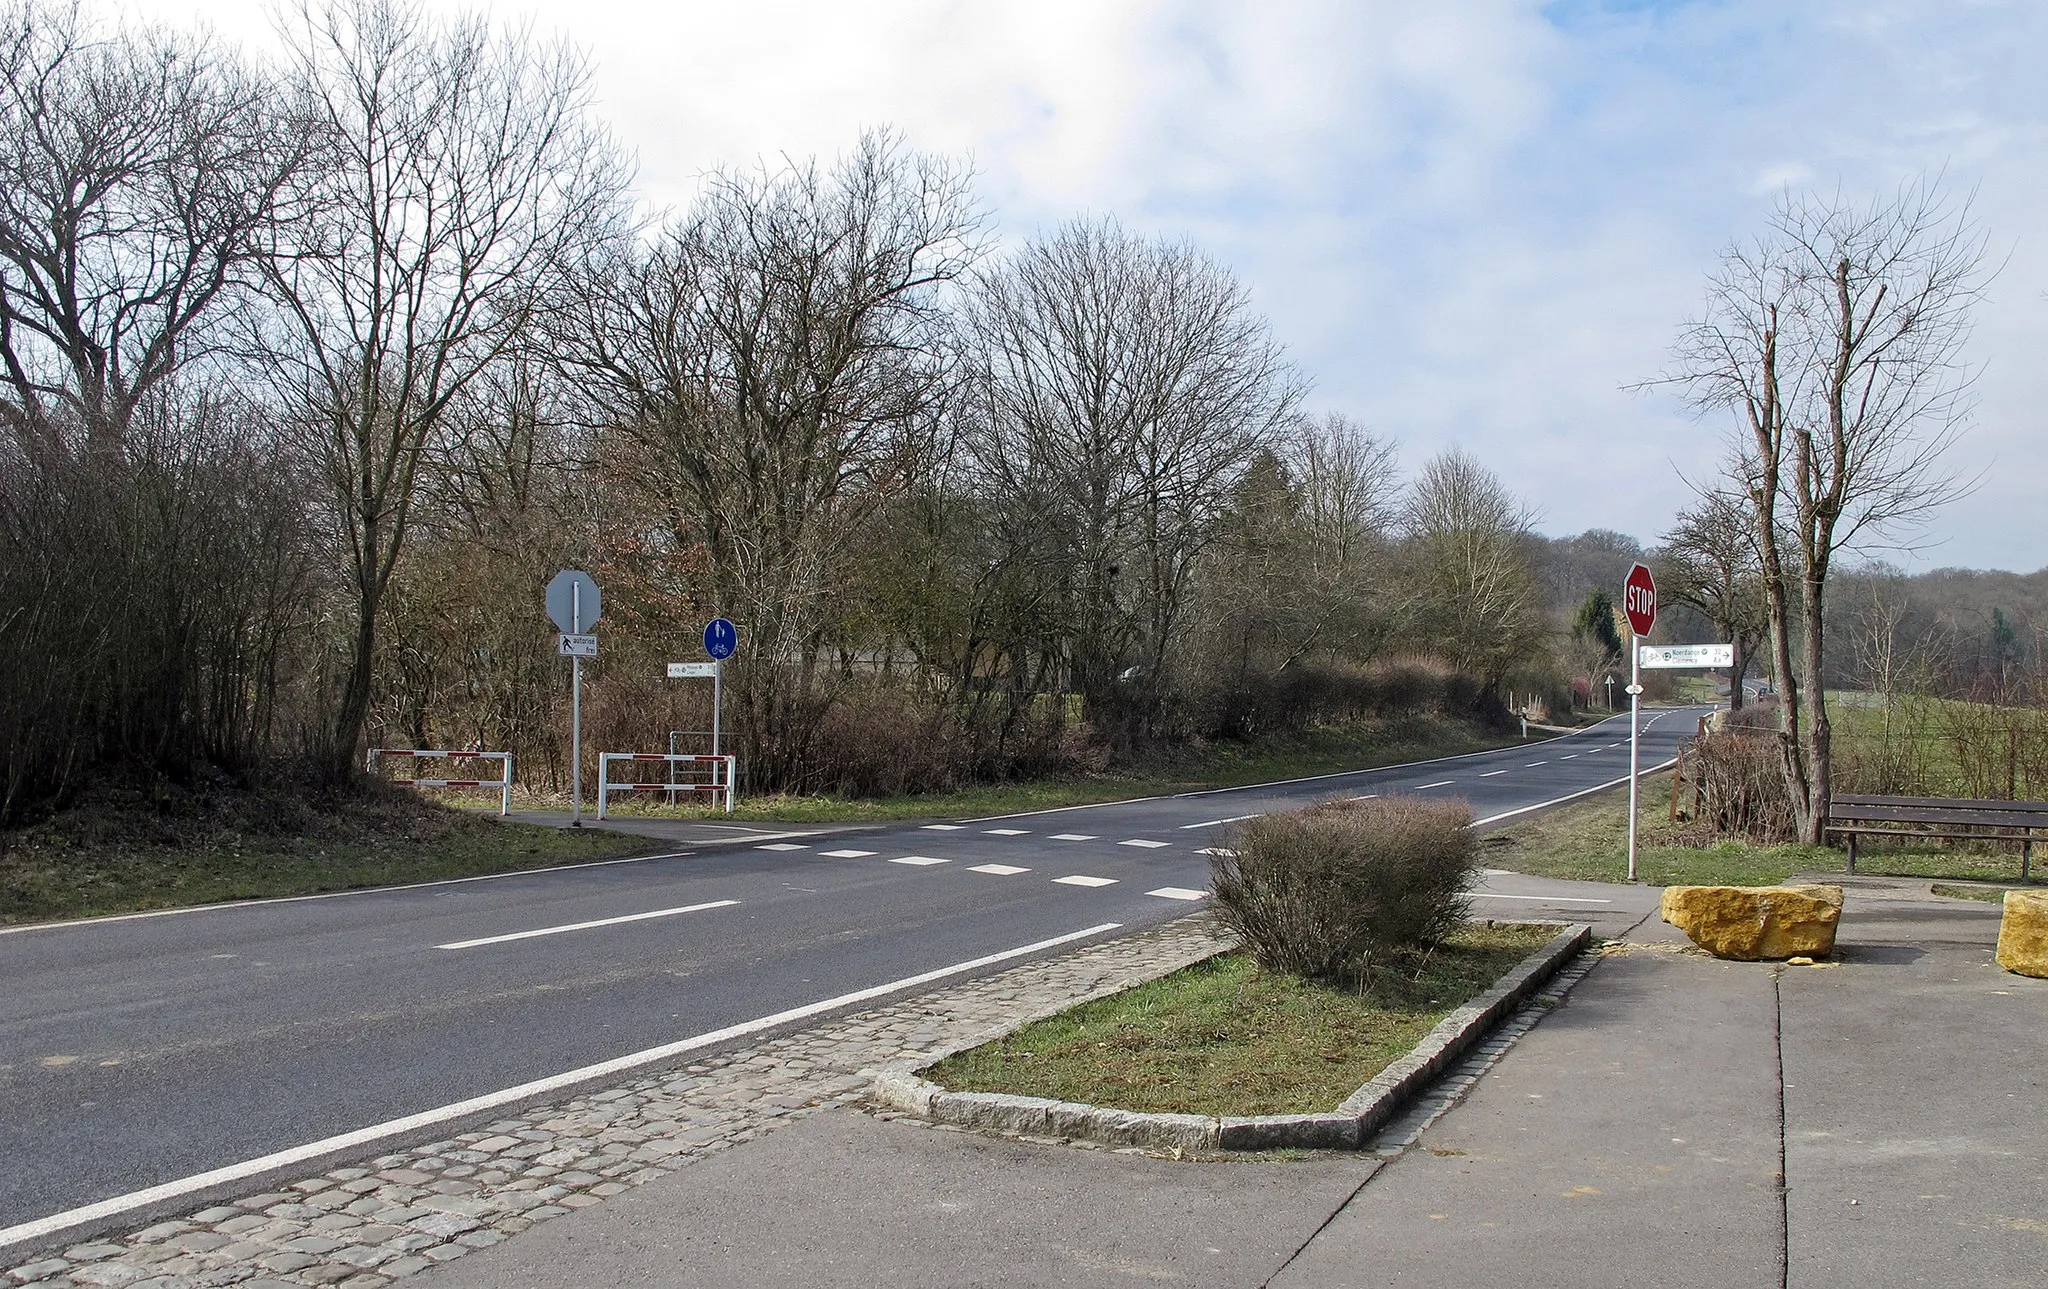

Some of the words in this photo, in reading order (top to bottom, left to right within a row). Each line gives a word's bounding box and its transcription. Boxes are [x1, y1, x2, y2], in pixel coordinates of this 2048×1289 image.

[1628, 585, 1653, 616] STOP
[573, 637, 595, 645] autorisé
[586, 646, 596, 654] frei
[1672, 648, 1701, 657] Noerdange
